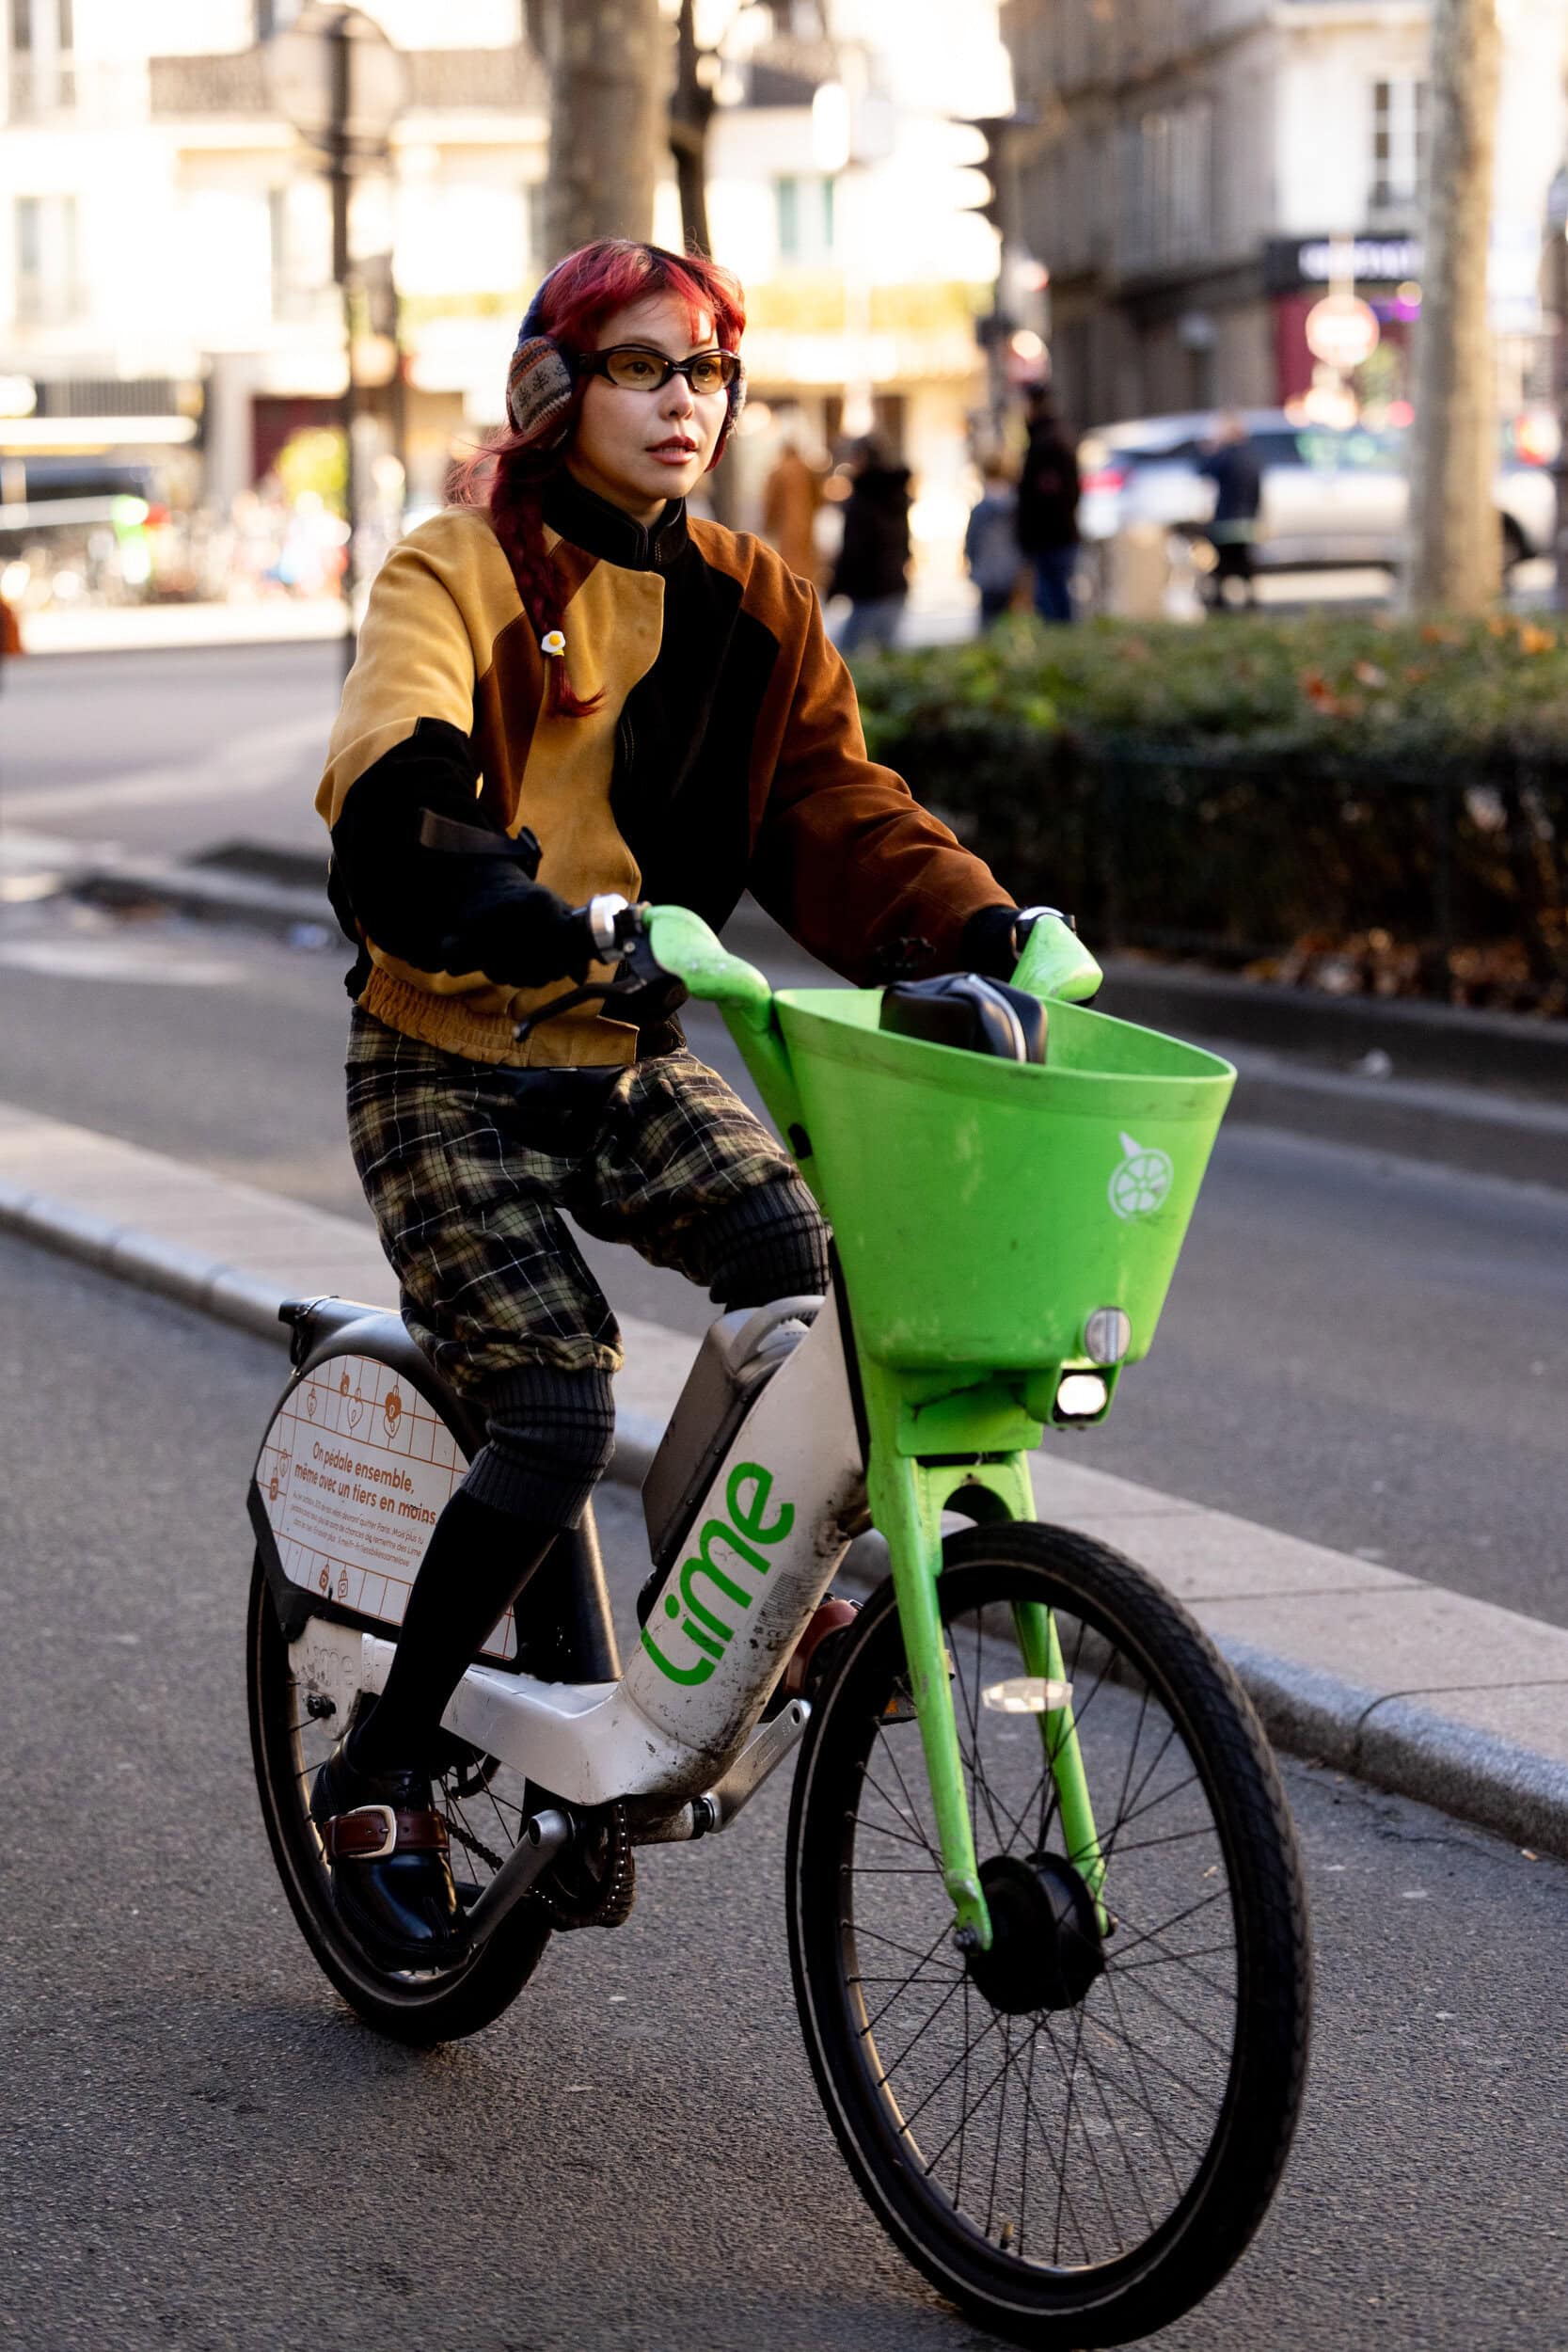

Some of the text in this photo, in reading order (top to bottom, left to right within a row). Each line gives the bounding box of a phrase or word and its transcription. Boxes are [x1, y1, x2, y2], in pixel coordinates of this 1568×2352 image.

[294, 1462, 318, 1485] même
[319, 1474, 337, 1493] avec
[338, 1483, 350, 1499] un
[353, 1484, 377, 1507] tiers
[380, 1496, 395, 1513] en
[313, 1441, 415, 1494] On pédale ensemble,
[640, 1461, 796, 1686] Lime
